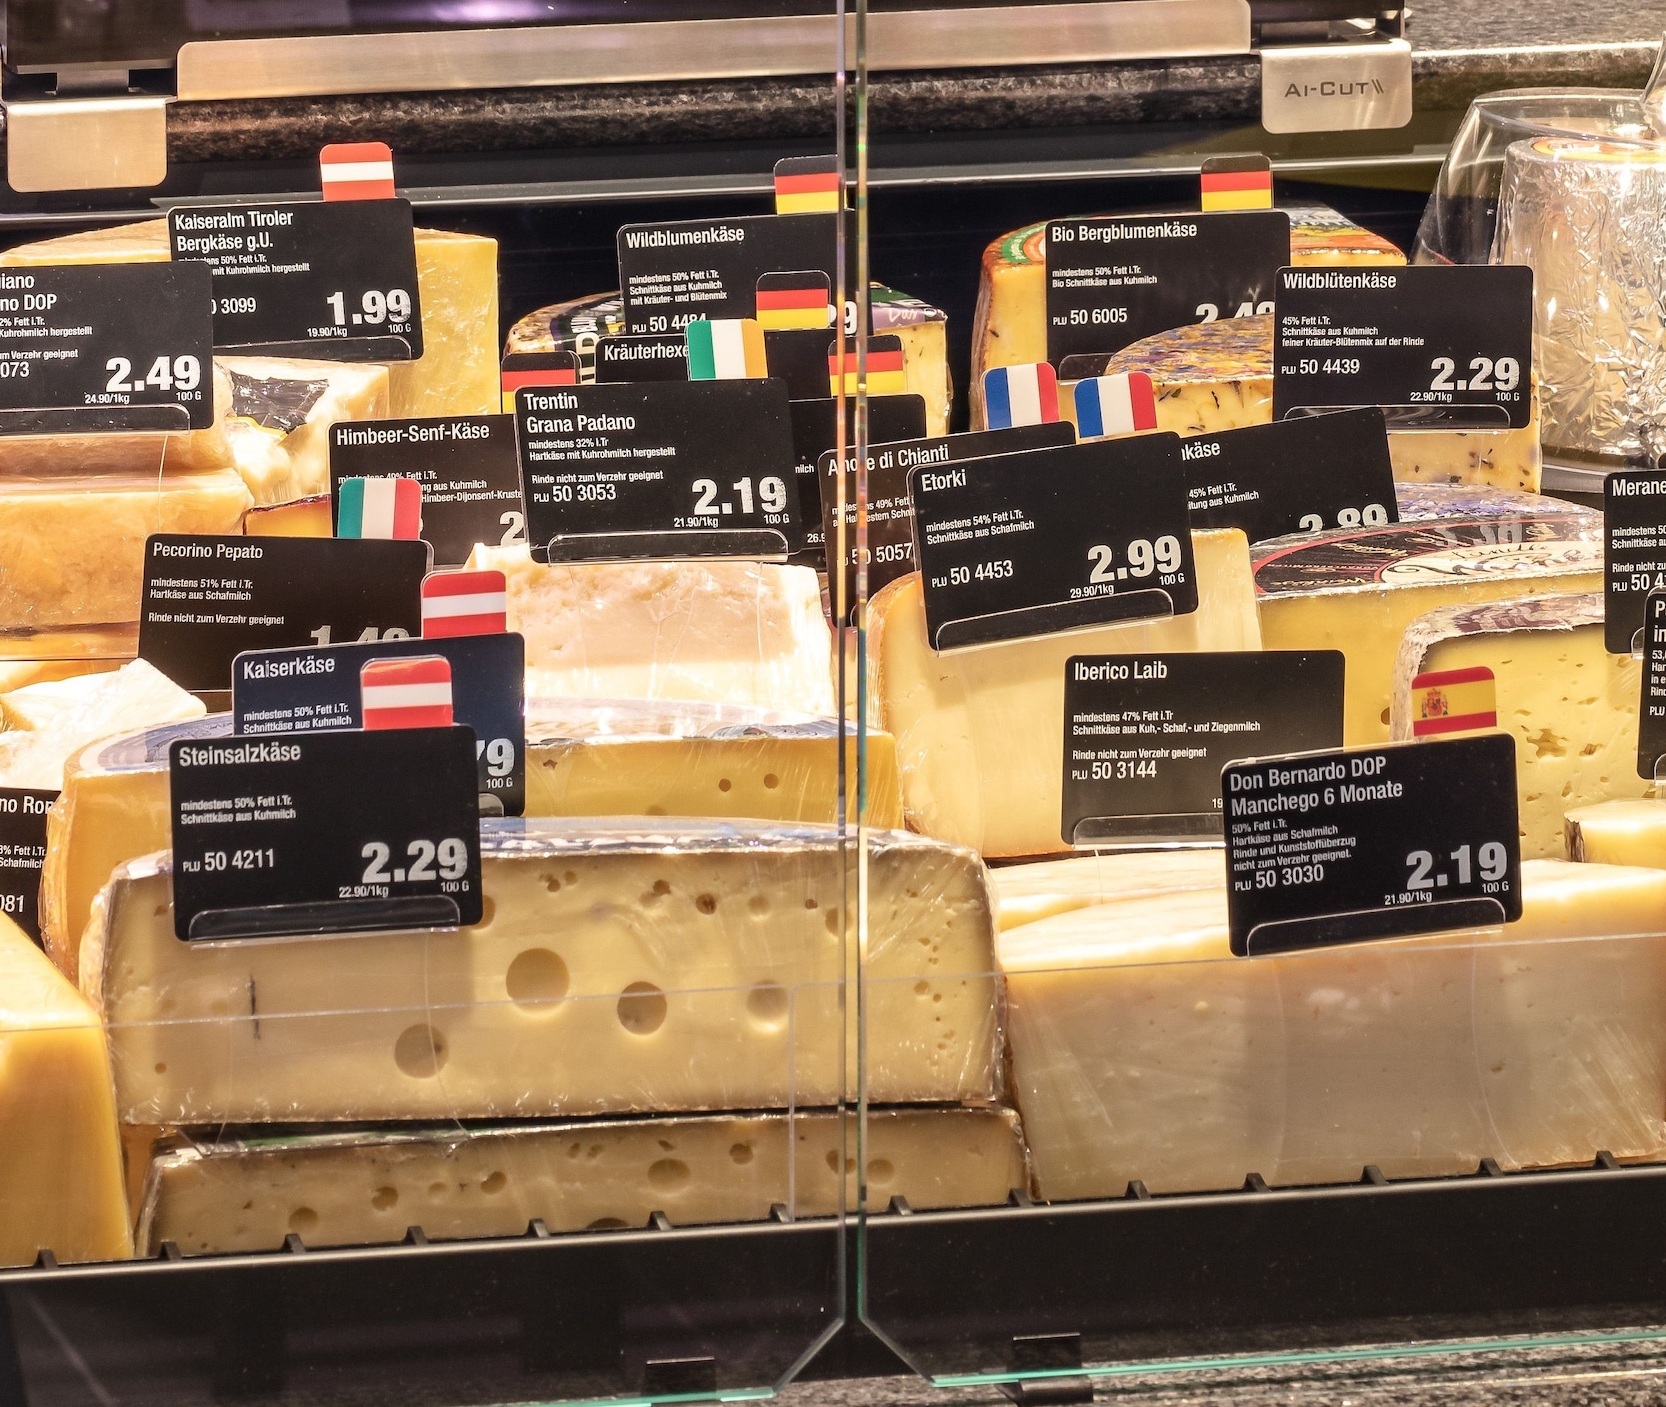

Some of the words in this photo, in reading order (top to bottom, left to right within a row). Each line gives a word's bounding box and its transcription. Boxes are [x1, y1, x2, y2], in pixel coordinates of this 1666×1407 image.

[175, 212, 245, 230] Kaiseralm
[247, 209, 293, 227] Tiroler
[176, 233, 243, 254] Bergkäse
[246, 231, 273, 252] g.U.
[625, 225, 744, 248] Wildblumenkäse
[1052, 226, 1074, 242] Bio
[1078, 220, 1197, 243] Bergblumenkäse
[1283, 271, 1396, 289] Wildblütenkäse
[23, 293, 57, 310] DOP
[326, 288, 411, 325] 1.99
[105, 355, 201, 392] 2.49
[1430, 357, 1520, 391] 2.29
[84, 393, 130, 405] 24.90/1kg
[175, 390, 193, 401] 100
[194, 390, 201, 400] G
[523, 392, 578, 410] Trentin
[336, 422, 489, 445] Himbeer-Senf-Käse
[526, 416, 574, 433] Grana
[576, 413, 635, 431] Padano
[921, 468, 966, 492] Etorki
[691, 476, 787, 515] 2.19
[153, 542, 212, 557] Pecorino
[216, 543, 263, 561] Pepato
[1087, 535, 1181, 584] 2.99
[243, 655, 335, 679] Kaiserkäse
[1074, 661, 1129, 680] Iberico
[1133, 660, 1167, 679] Laib
[1650, 673, 1659, 684] in
[179, 741, 301, 767] Steinsalzkäse
[1230, 773, 1263, 791] Don
[1268, 761, 1346, 787] Bernardo
[1350, 755, 1386, 777] DOP
[1231, 792, 1319, 816] Manchego
[1323, 787, 1335, 805] 6
[1340, 780, 1403, 803] Monate
[361, 837, 468, 884] 2.29
[1405, 841, 1507, 890] 2.19
